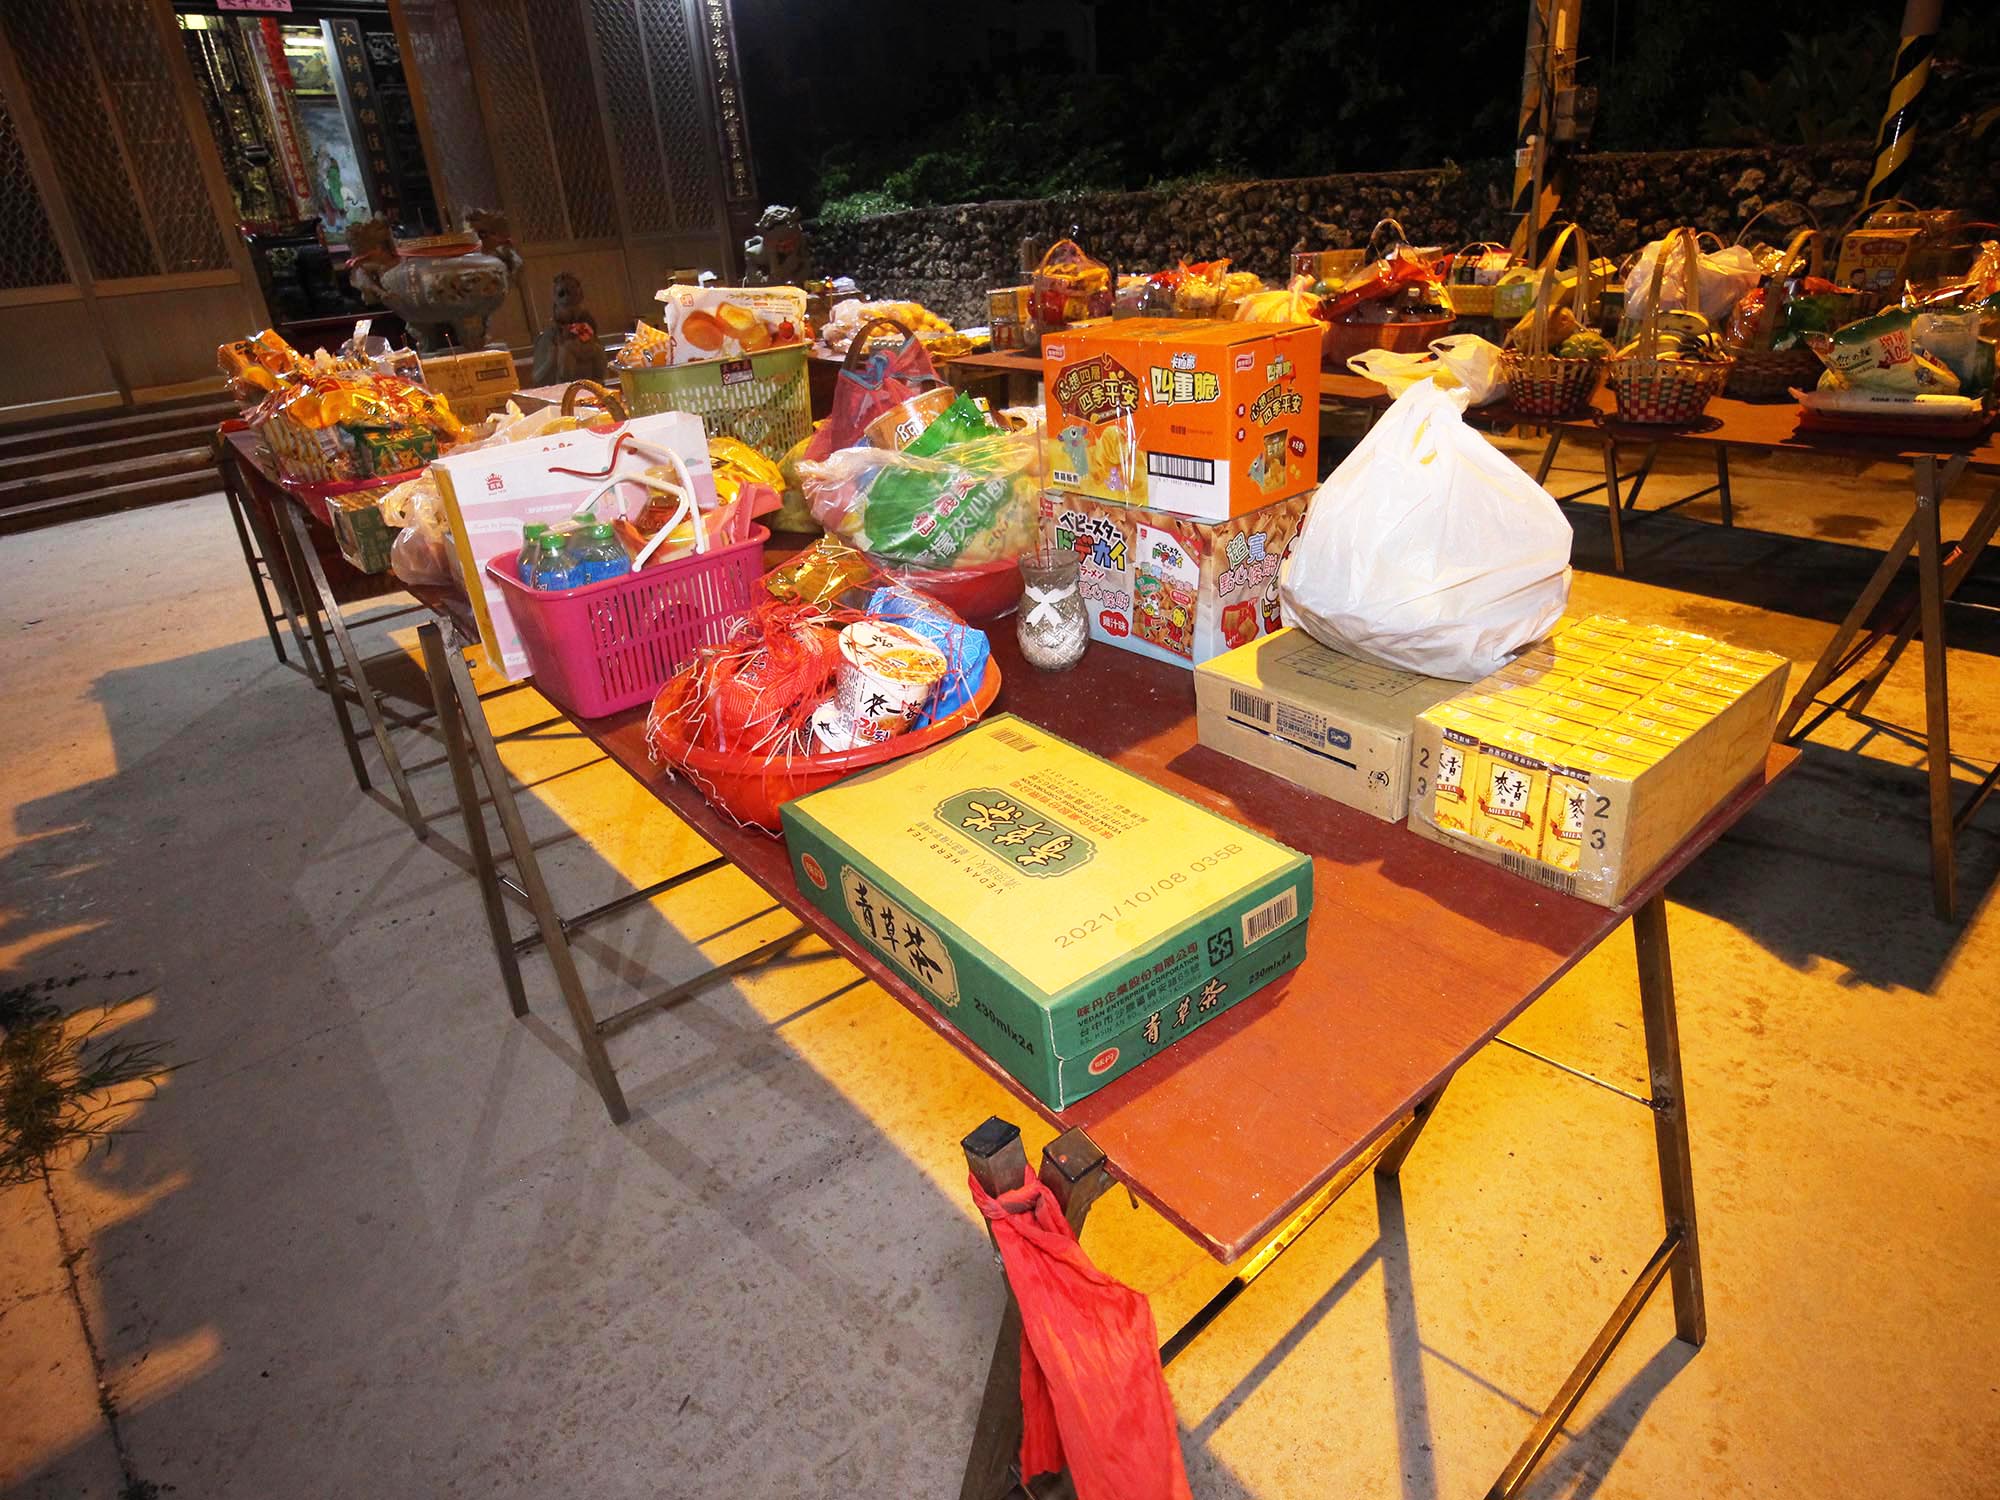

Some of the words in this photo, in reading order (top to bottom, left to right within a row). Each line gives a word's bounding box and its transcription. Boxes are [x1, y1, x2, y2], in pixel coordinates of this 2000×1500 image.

[1058, 365, 1101, 400] 心想四層
[1079, 381, 1139, 413] 四季平安
[1262, 394, 1302, 425] 四季平安
[1060, 513, 1122, 541] ベビースター
[1057, 528, 1127, 572] ドデカイ
[1420, 748, 1430, 768] 2
[1417, 777, 1427, 795] 3
[1494, 770, 1528, 801] 麥香
[1488, 806, 1506, 817] MILK
[1507, 809, 1522, 819] TEA
[1594, 797, 1611, 819] 2
[906, 827, 924, 842] TEA
[961, 801, 1073, 866] 青草茶
[1590, 829, 1606, 850] 3
[930, 844, 961, 864] HERB
[963, 866, 1004, 895] VEDAN
[1054, 872, 1187, 948] 2021/10/08
[1190, 843, 1244, 873] 035B
[855, 881, 944, 984] 青草茶
[1077, 942, 1198, 1018] 味丹企業股份有限公司
[1078, 1009, 1105, 1026] VEDAN
[1106, 984, 1150, 1013] ENTERPRISE
[1151, 954, 1199, 986] CORPORATION
[1142, 975, 1228, 1045] 青草茶
[974, 998, 1035, 1056] 230mlx24
